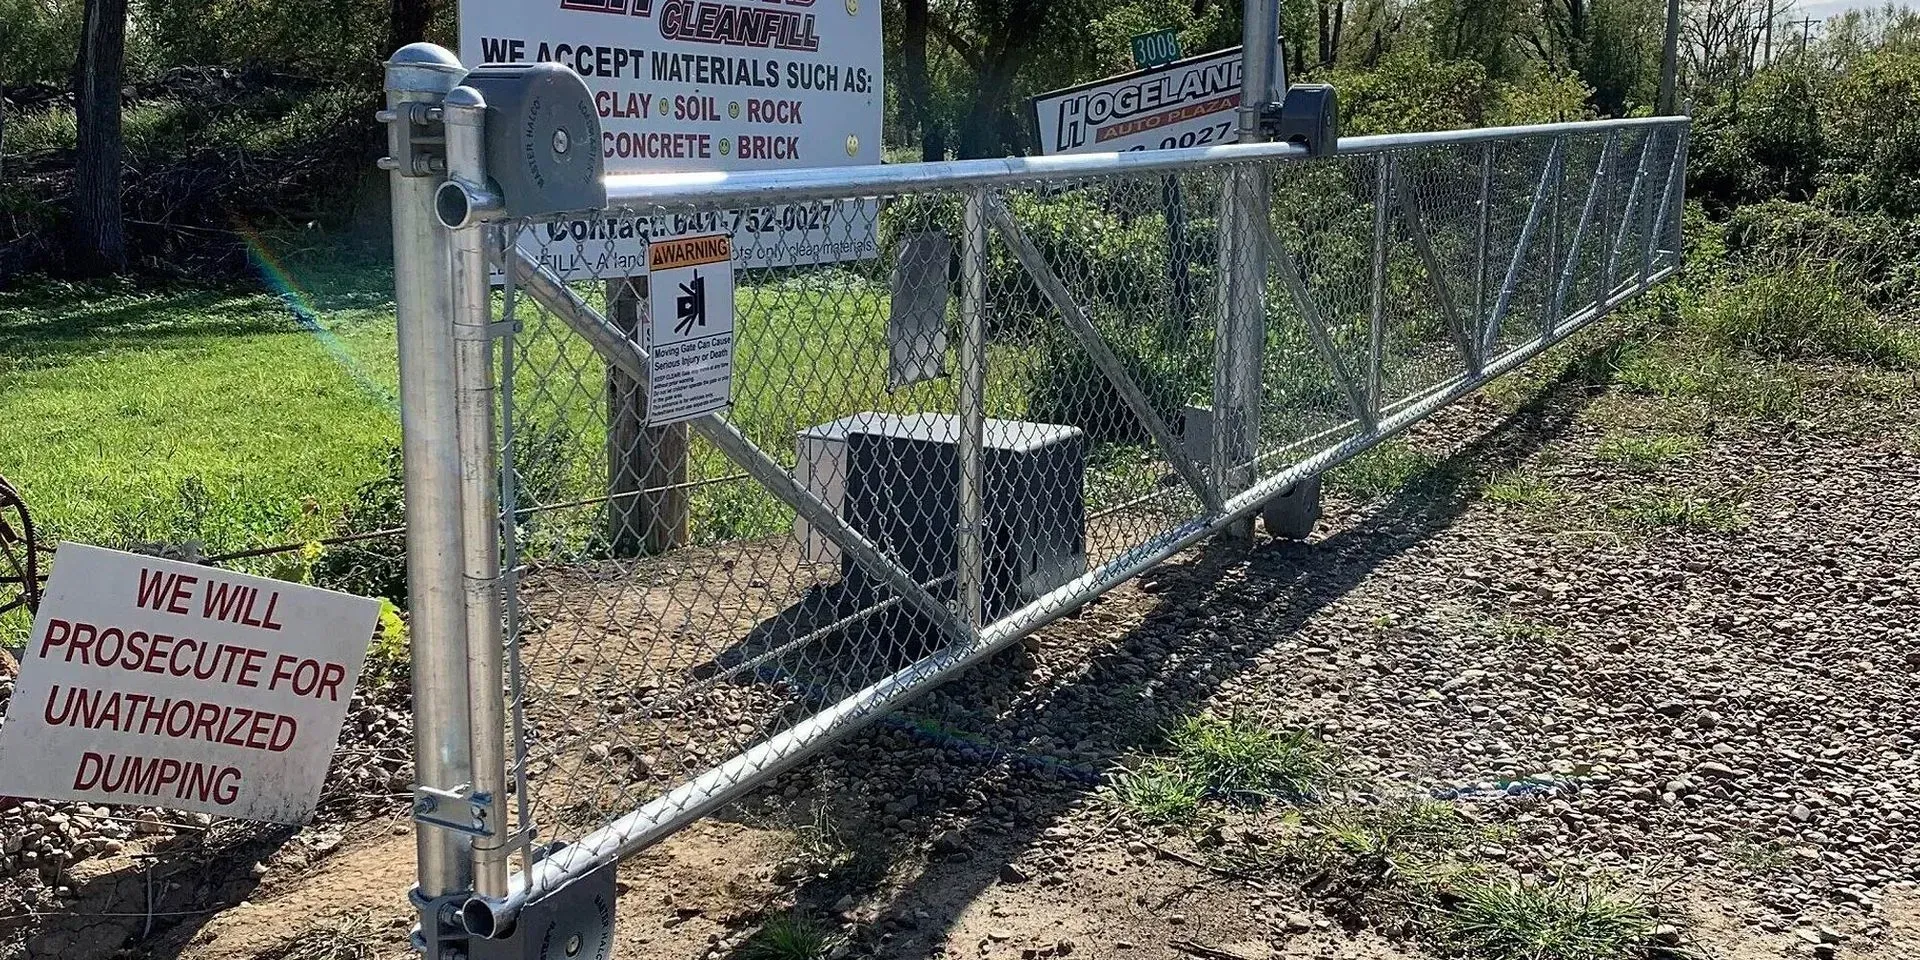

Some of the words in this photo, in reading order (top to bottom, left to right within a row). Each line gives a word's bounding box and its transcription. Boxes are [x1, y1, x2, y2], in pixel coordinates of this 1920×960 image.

[659, 0, 820, 51] CLEANFILL
[1136, 34, 1176, 64] 3008
[481, 37, 525, 63] WE
[536, 42, 644, 79] ACCEPT
[652, 51, 779, 88] MATERIALS
[787, 62, 838, 91] SUCH
[844, 66, 872, 94] AS:
[596, 90, 653, 119] CLAY
[674, 95, 721, 121] SOIL
[747, 99, 803, 124] ROCK
[1103, 116, 1161, 140] AUTO
[1168, 98, 1232, 122] PLAZA
[602, 131, 711, 159] CONCRETE
[738, 136, 800, 160] BRICK
[674, 204, 832, 235] 641-752-0027
[661, 238, 728, 263] WARNING
[757, 243, 785, 262] only
[654, 360, 681, 371] Serious
[682, 355, 700, 366] Injury
[701, 353, 709, 361] or
[709, 348, 728, 360] Death
[655, 347, 680, 358] Moving
[681, 343, 696, 353] Gate
[698, 340, 711, 350] Can
[711, 337, 731, 347] Cause
[136, 567, 198, 615] WE
[202, 579, 283, 631] WILL
[39, 619, 266, 687] PROSECUTE
[268, 654, 345, 701] FOR
[44, 685, 297, 752] UNATHORIZED
[73, 752, 241, 805] DUMPING
